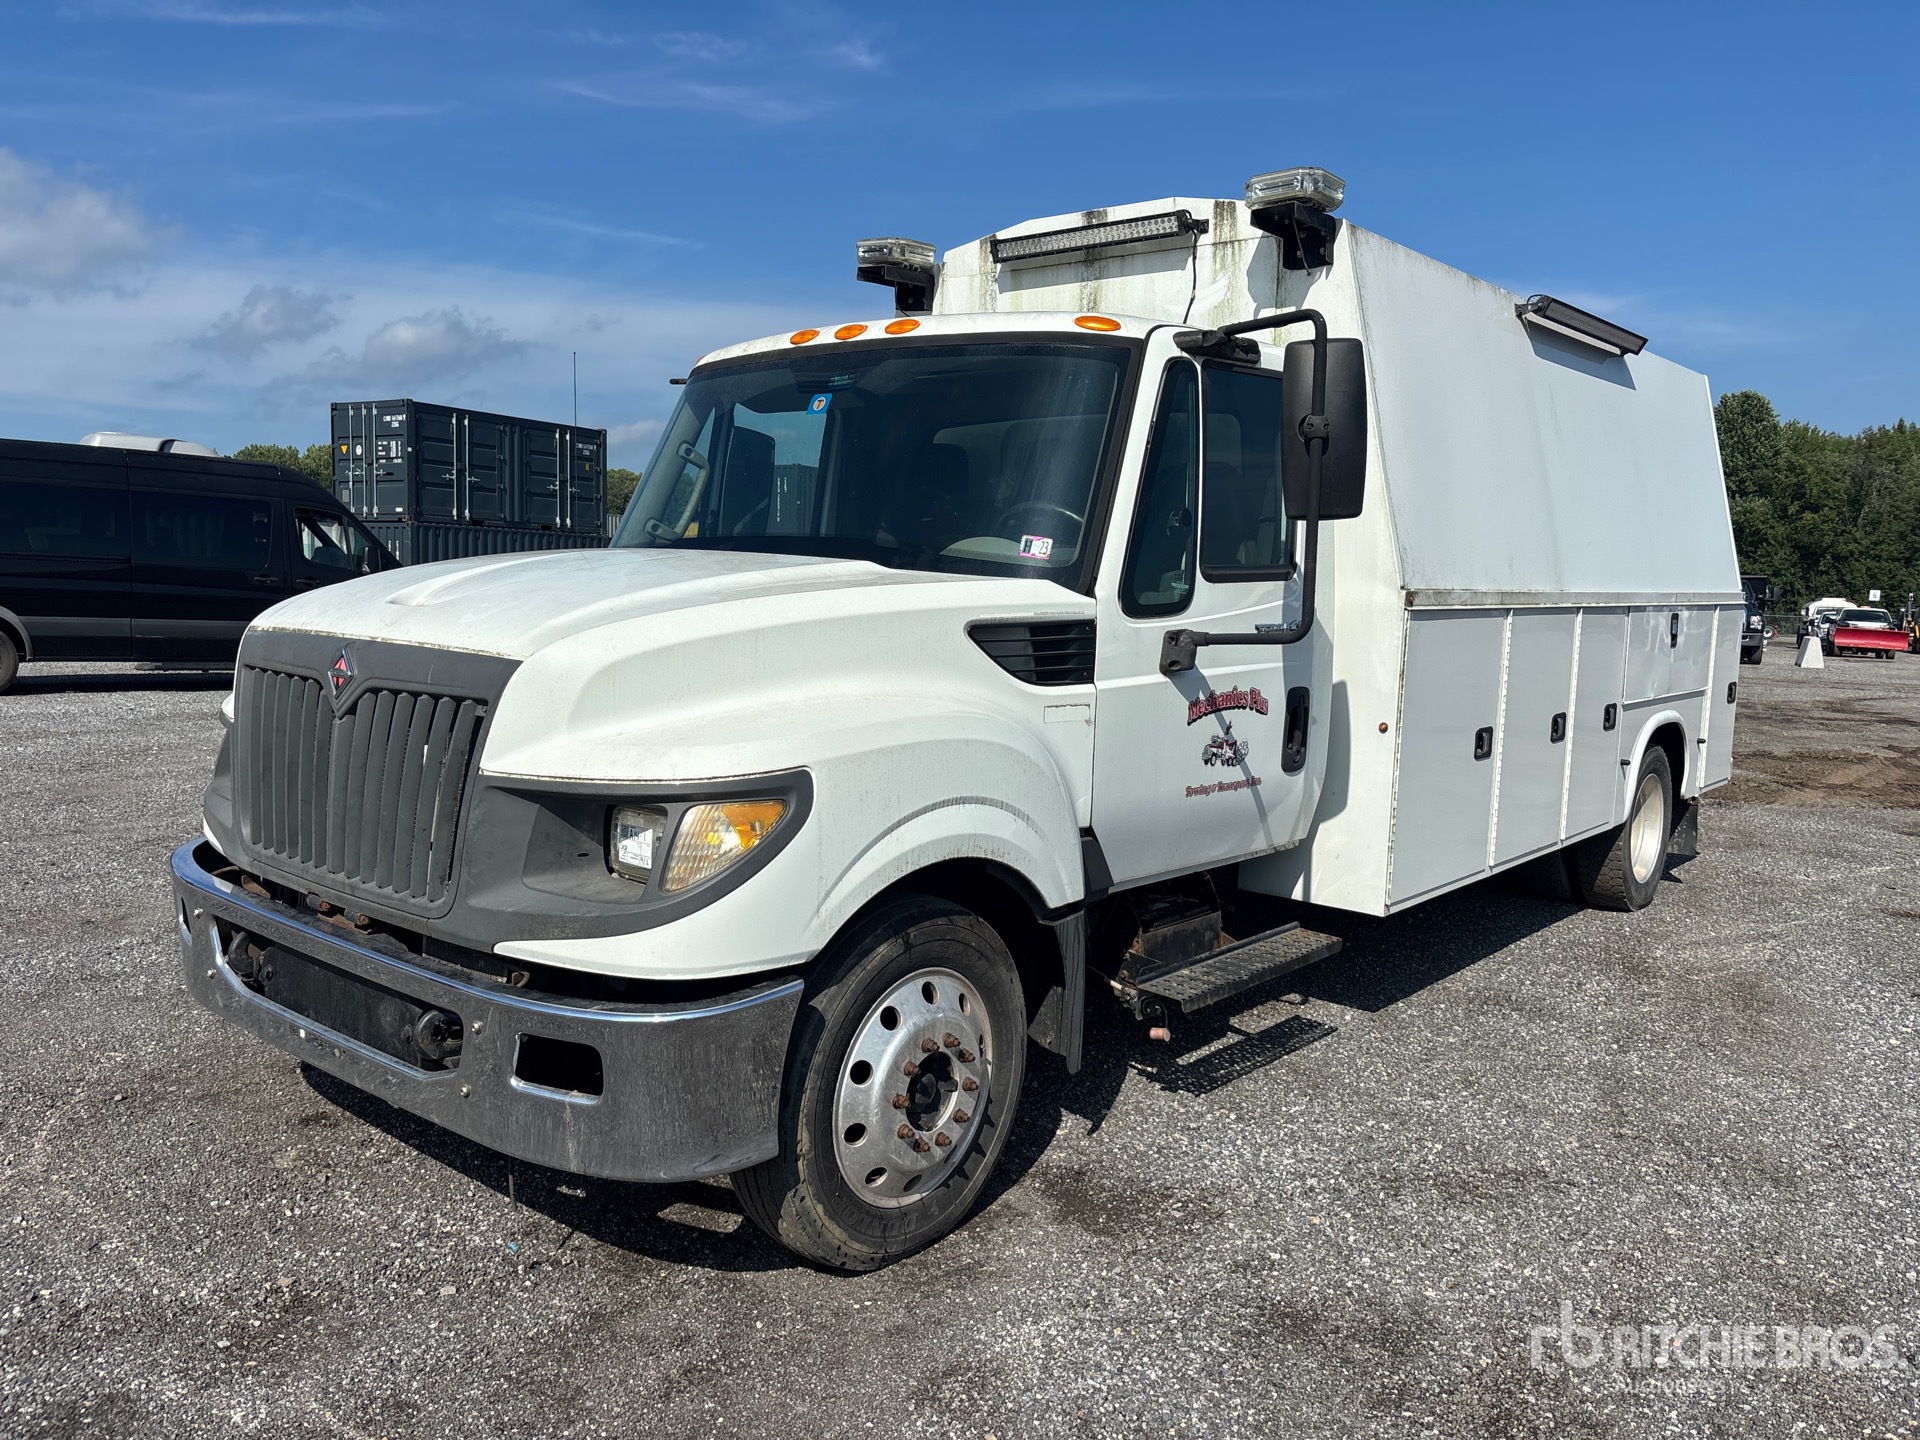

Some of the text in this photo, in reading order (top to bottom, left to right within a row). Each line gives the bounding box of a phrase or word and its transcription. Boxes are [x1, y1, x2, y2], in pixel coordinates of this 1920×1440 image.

[1039, 540, 1050, 555] 23
[1187, 685, 1269, 726] Mechanics Plus
